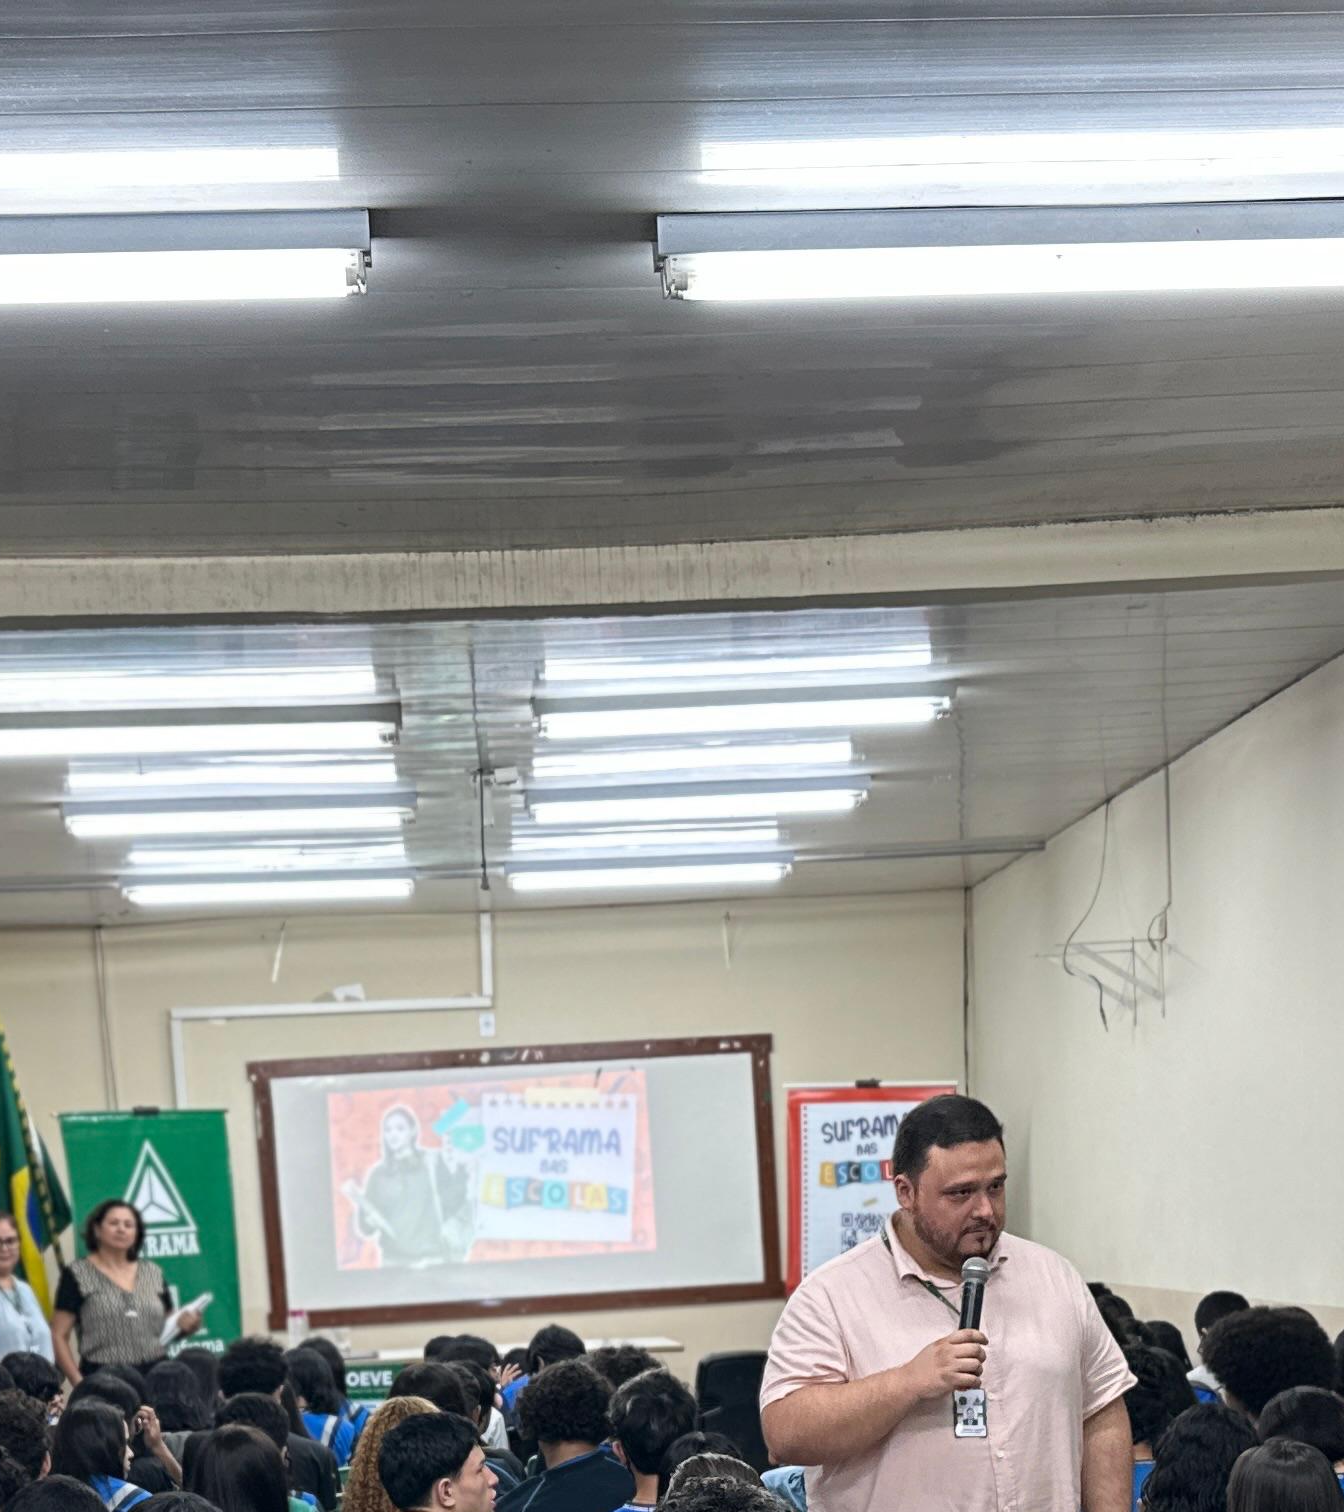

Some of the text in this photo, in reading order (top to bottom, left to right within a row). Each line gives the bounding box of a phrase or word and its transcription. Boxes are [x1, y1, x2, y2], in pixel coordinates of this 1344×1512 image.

[492, 1125, 622, 1157] SUFRAMA
[821, 1113, 908, 1144] SUFRAM
[856, 1142, 878, 1155] NAS
[820, 1160, 894, 1188] ESCOL
[484, 1175, 629, 1215] ESCOLAS
[141, 1233, 199, 1257] RAMA
